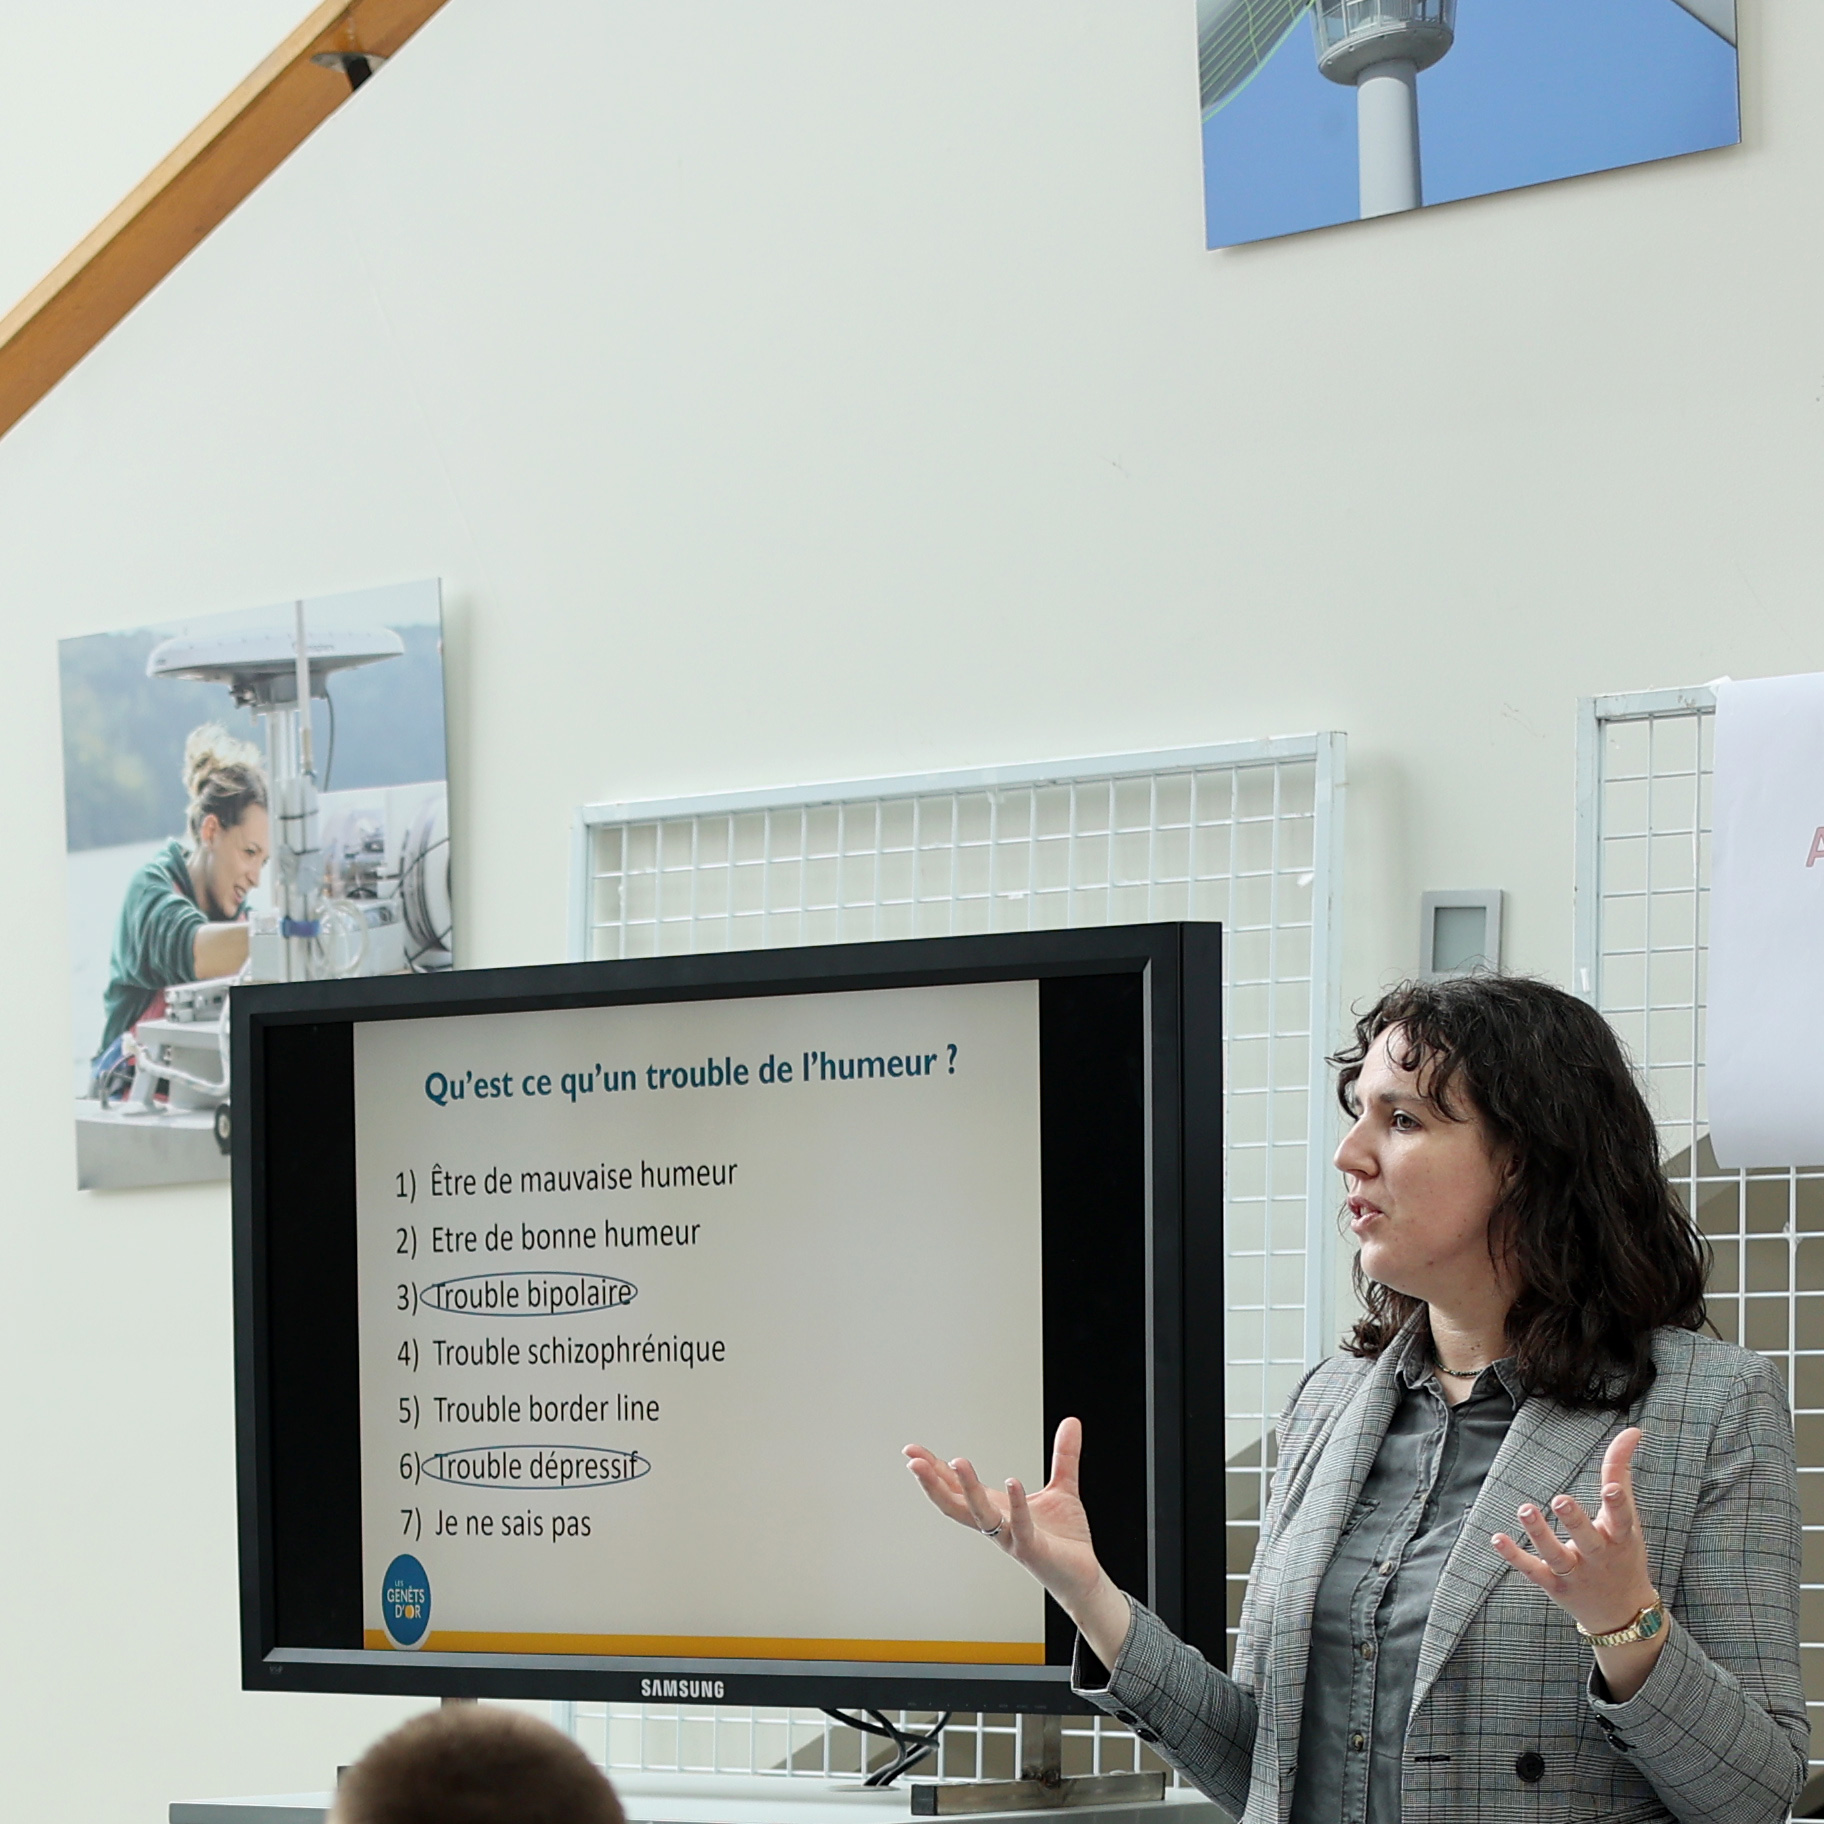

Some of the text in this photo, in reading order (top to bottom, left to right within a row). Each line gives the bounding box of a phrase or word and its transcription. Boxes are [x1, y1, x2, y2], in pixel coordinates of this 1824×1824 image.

[425, 1070, 513, 1106] Qu'est
[522, 1075, 551, 1096] ce
[561, 1063, 636, 1103] qu'un
[646, 1057, 749, 1090] trouble
[759, 1054, 793, 1084] de
[947, 1043, 958, 1074] ?
[396, 1160, 738, 1204] 1) Être de mauvaise humeur
[396, 1219, 701, 1260] 2) Etre de bonne humeur
[397, 1278, 631, 1316] 3) Trouble bipolaire
[397, 1333, 726, 1373] 4) Trouble schizophrénique
[399, 1394, 660, 1430] 5) Trouble border line
[399, 1450, 638, 1487] 6) Trouble dépressif
[400, 1507, 592, 1544] 7) Je ne sais pas
[386, 1585, 425, 1603] GENÊTS
[641, 1678, 725, 1699] SAMSUNG
